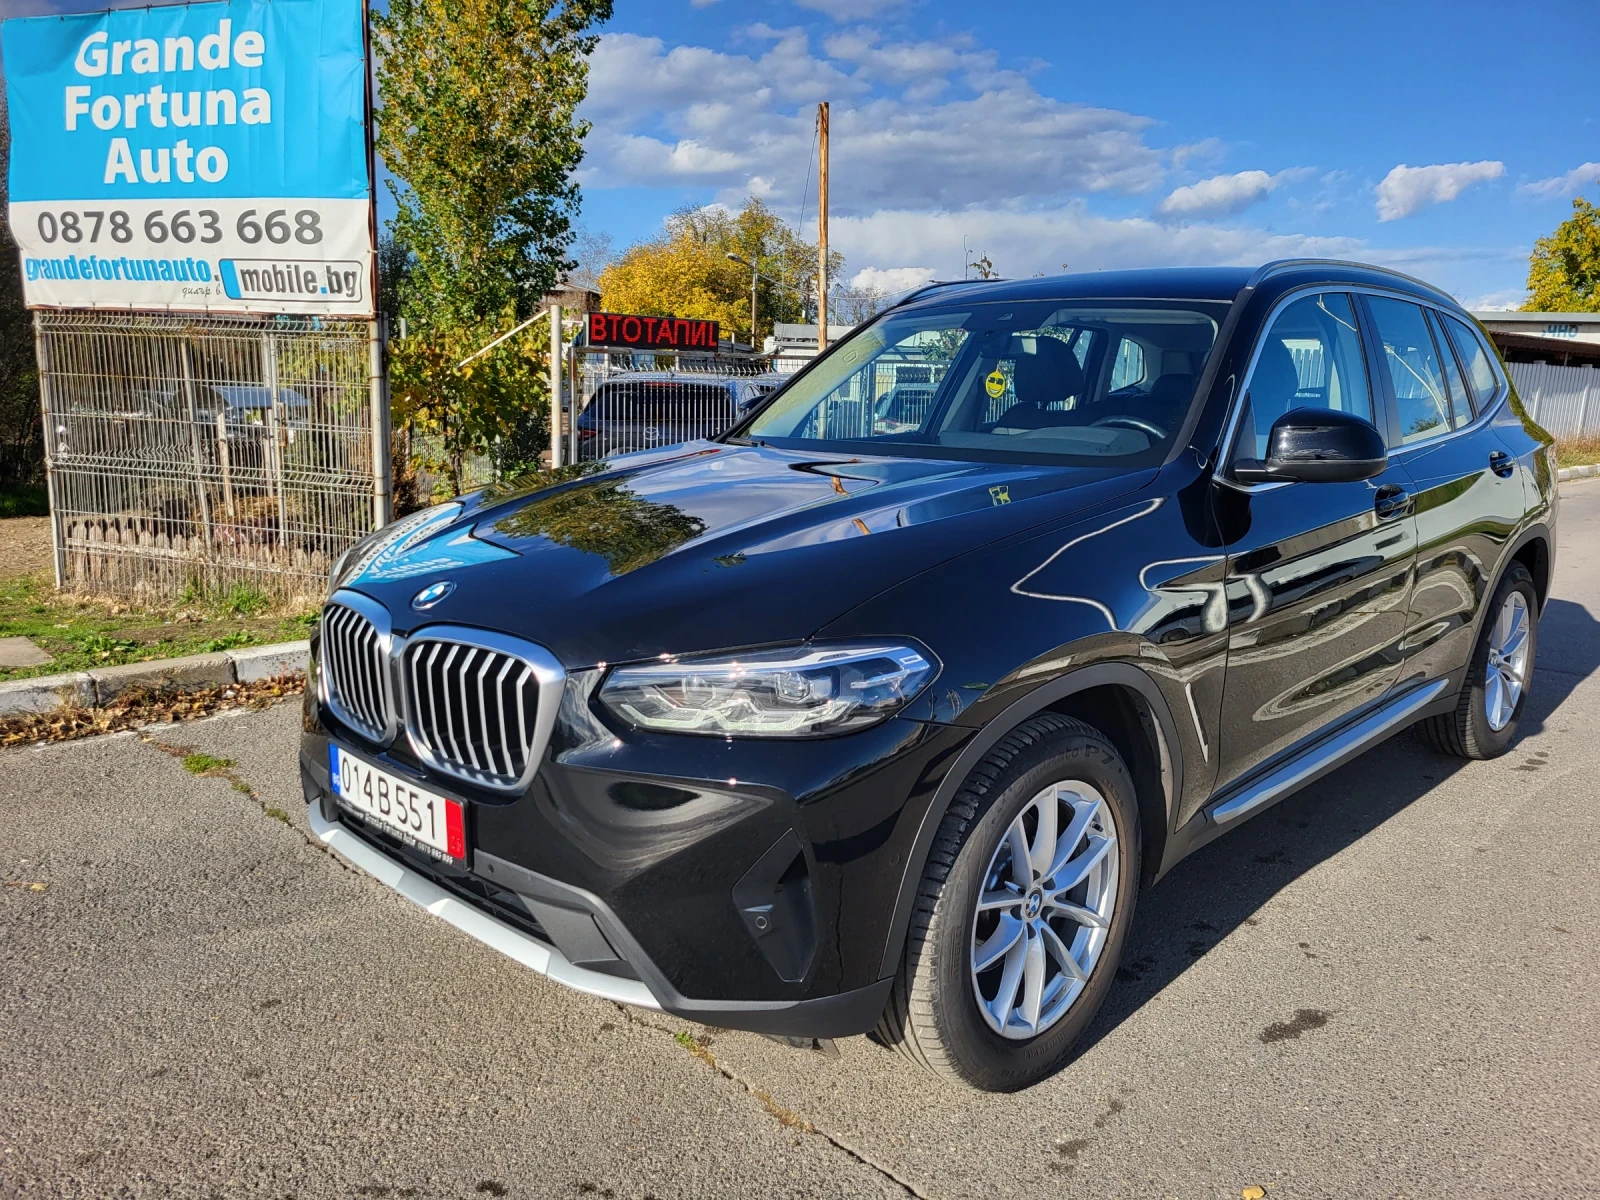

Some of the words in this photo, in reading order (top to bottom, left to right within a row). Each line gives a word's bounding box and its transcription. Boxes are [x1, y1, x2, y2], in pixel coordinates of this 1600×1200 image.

[74, 18, 265, 77] Grande
[64, 84, 272, 131] Fortuna
[103, 137, 229, 184] Auto
[37, 210, 134, 244] 0878
[144, 210, 223, 243] 663
[236, 209, 323, 245] 668
[240, 264, 358, 299] mobile.bg
[341, 755, 436, 840] 014B551
